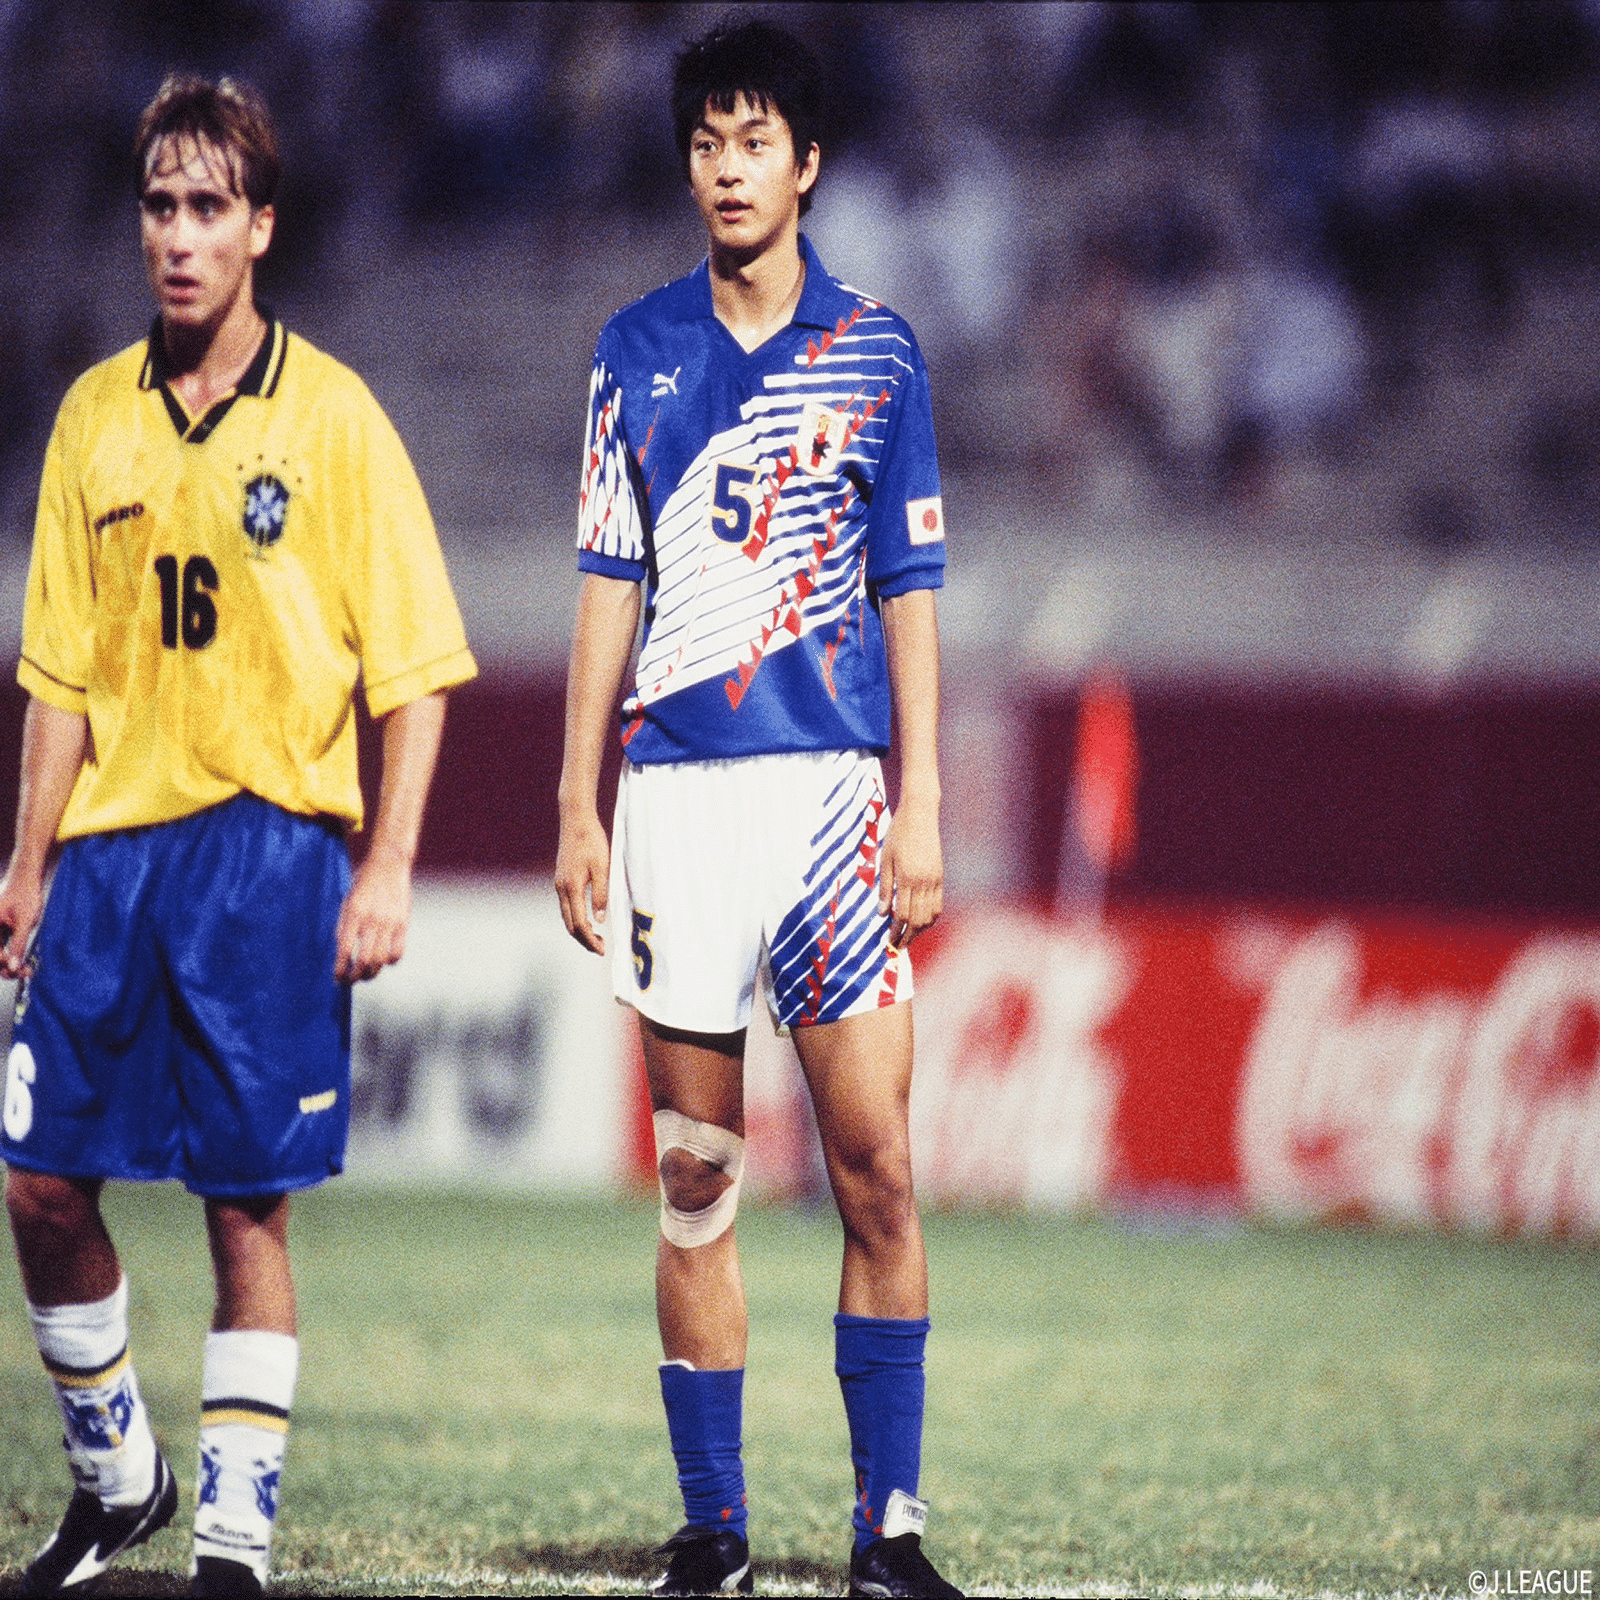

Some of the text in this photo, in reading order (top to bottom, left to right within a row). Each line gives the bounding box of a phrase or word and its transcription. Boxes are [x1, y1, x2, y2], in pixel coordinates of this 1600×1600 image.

[710, 462, 759, 545] 5
[155, 555, 219, 650] 16
[631, 910, 656, 992] 5
[3, 1042, 37, 1141] 6
